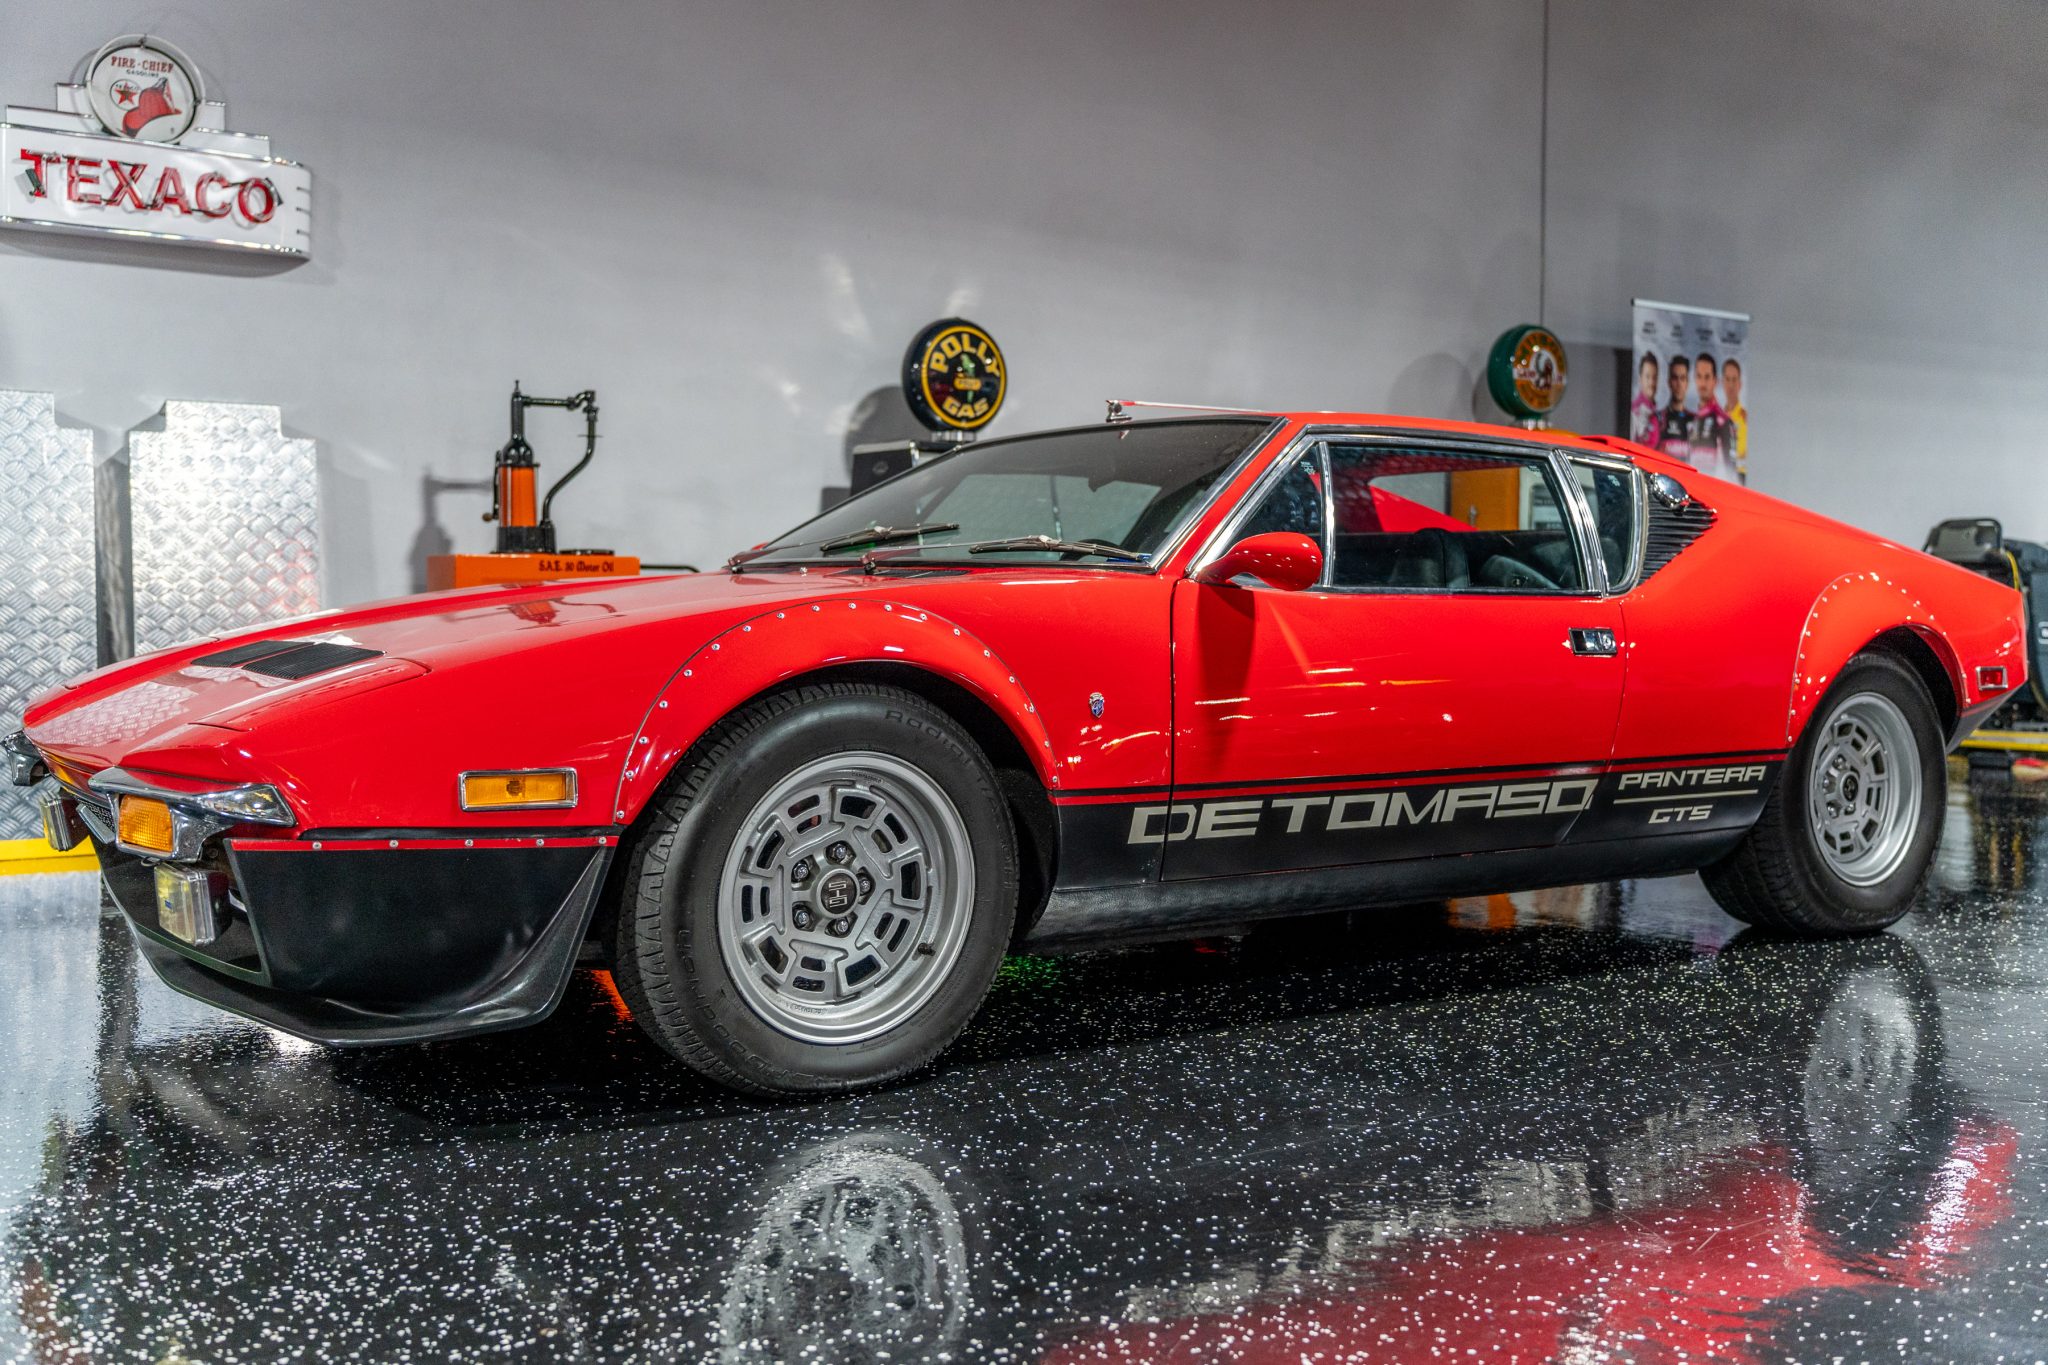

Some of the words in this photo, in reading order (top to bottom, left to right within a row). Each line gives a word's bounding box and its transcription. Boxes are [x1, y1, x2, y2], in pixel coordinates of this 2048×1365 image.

[20, 148, 277, 224] TEXACO
[929, 333, 1001, 377] POLLY
[942, 396, 989, 419] GAS
[1618, 766, 1767, 791] PANTERA
[1648, 804, 1713, 824] GTS
